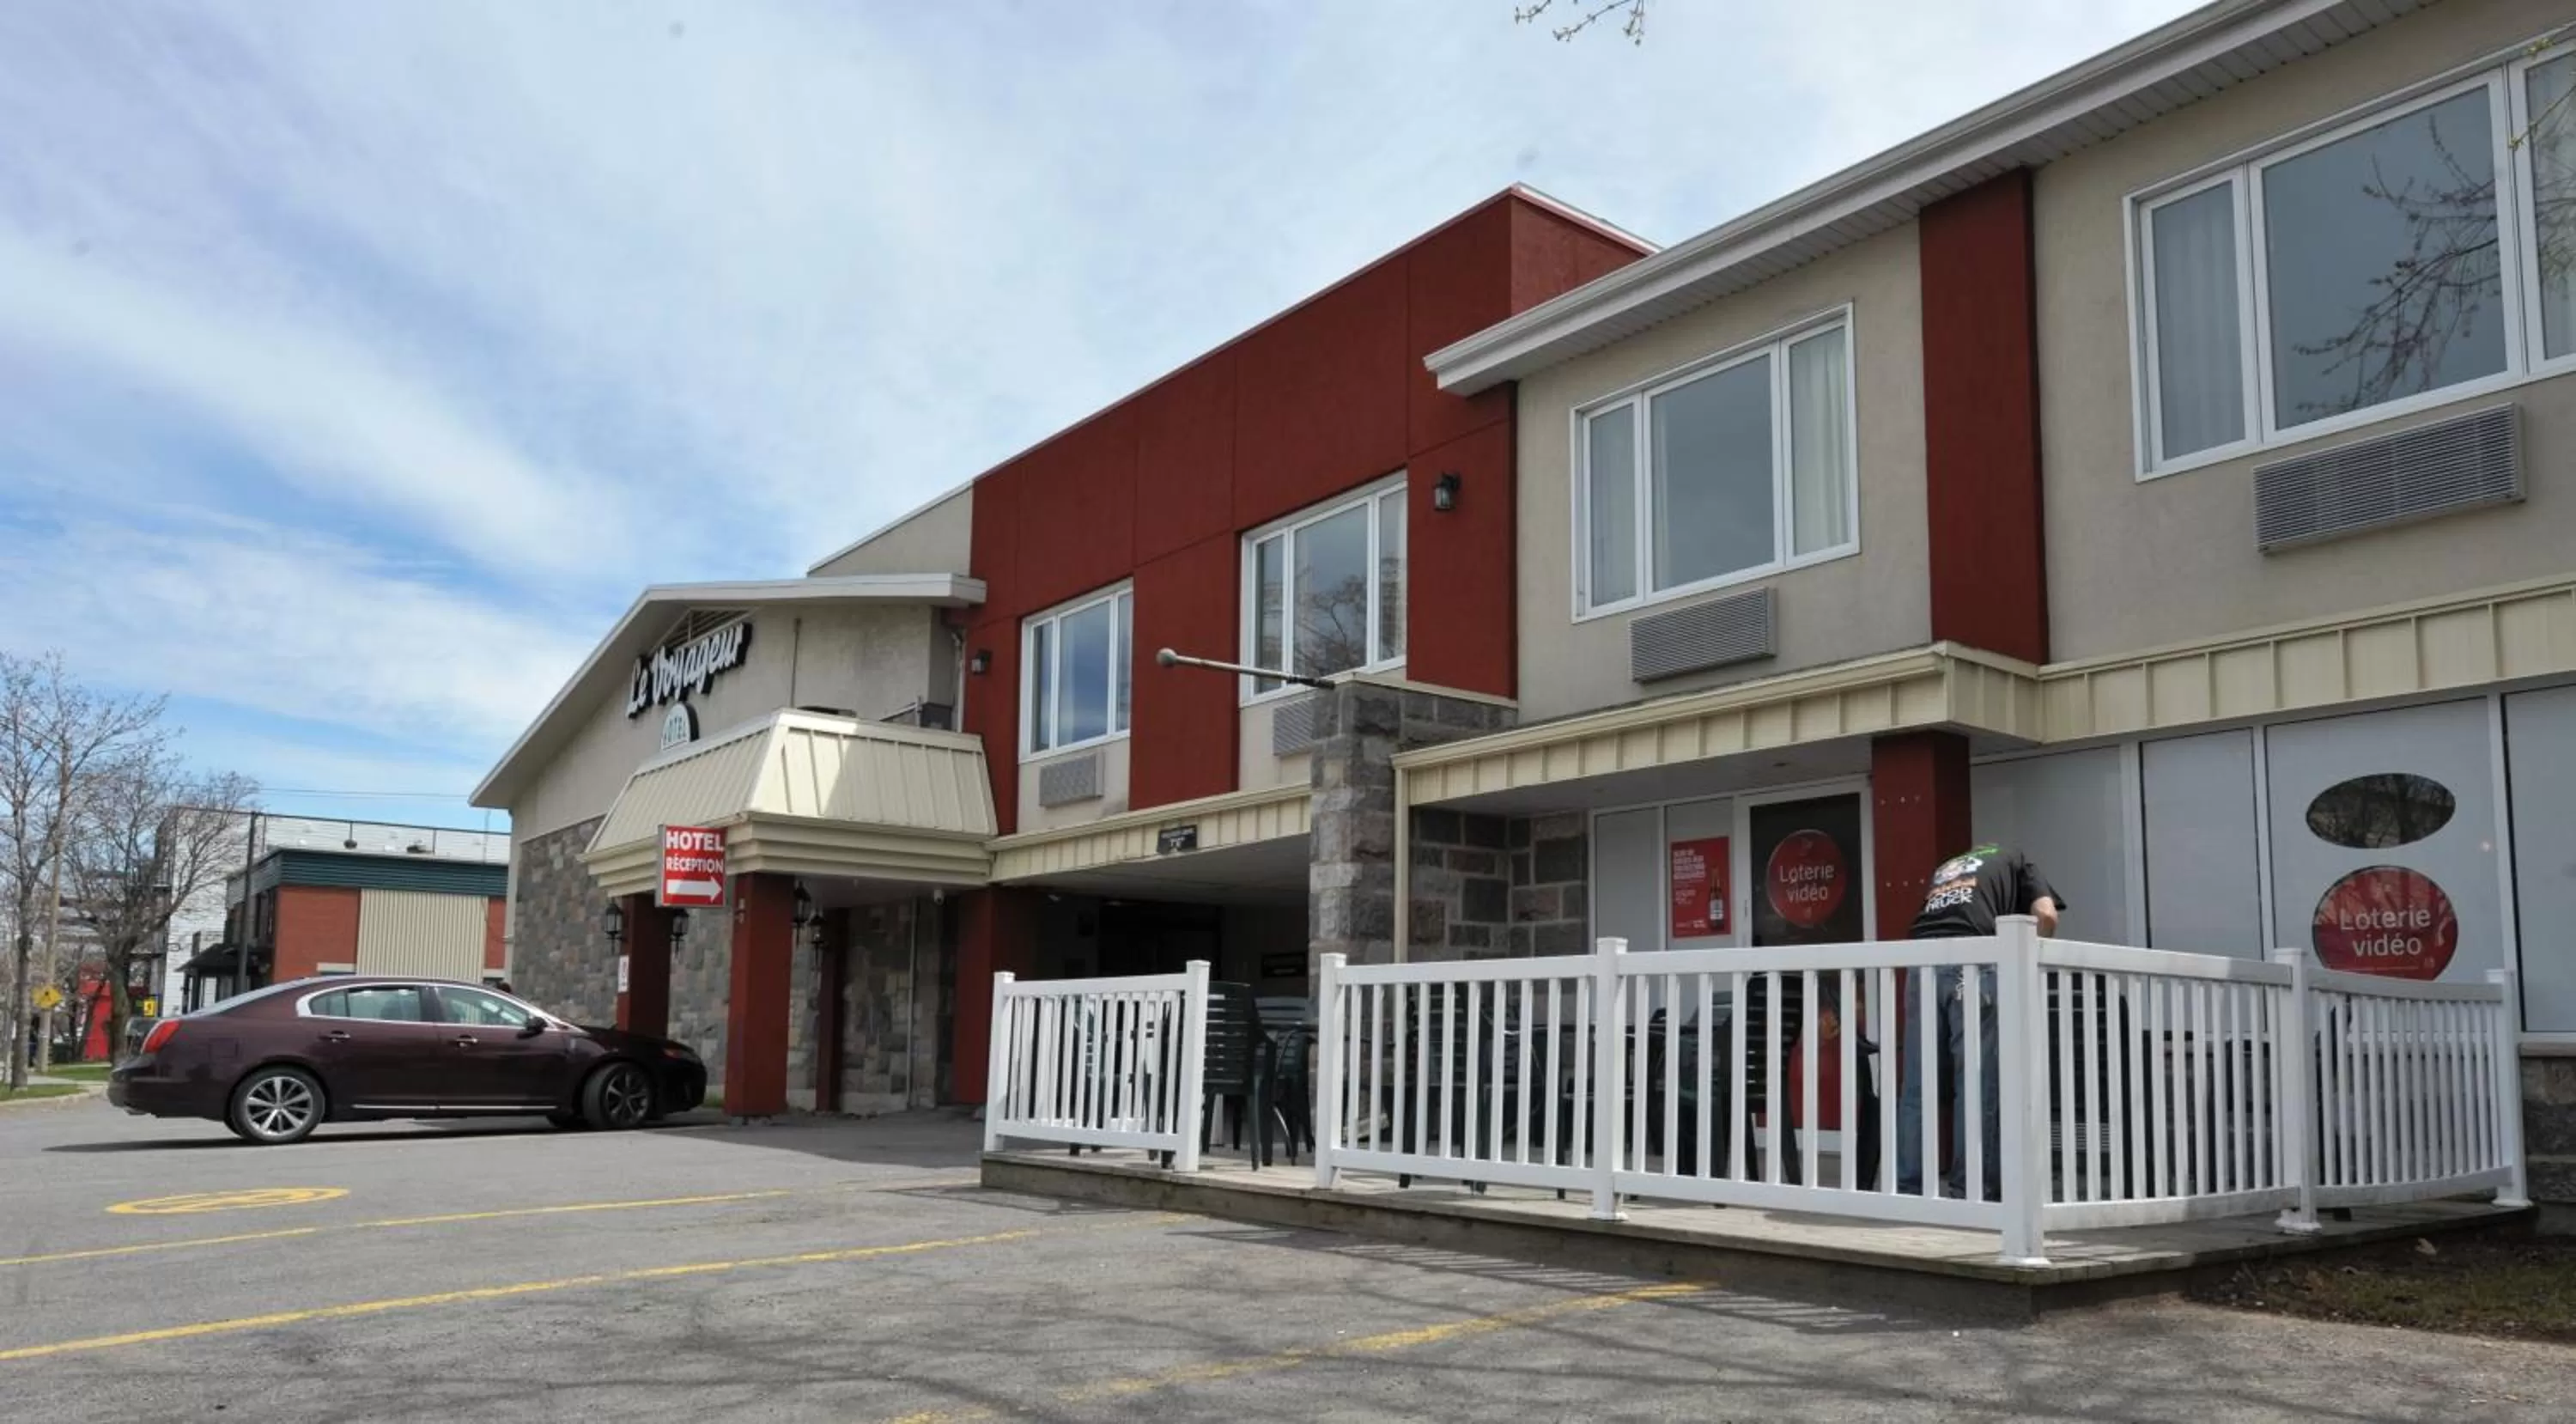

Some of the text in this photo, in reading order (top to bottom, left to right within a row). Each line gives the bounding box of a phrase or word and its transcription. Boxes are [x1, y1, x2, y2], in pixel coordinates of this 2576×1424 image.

[625, 622, 747, 718] Le Voyageur
[665, 831, 725, 852] HOTEL
[665, 853, 724, 873] RÉCEPTION
[1779, 862, 1835, 883] Loterie
[1786, 883, 1828, 903] vidéo
[2339, 904, 2431, 930] Loterie
[2352, 933, 2422, 957] vidéo
